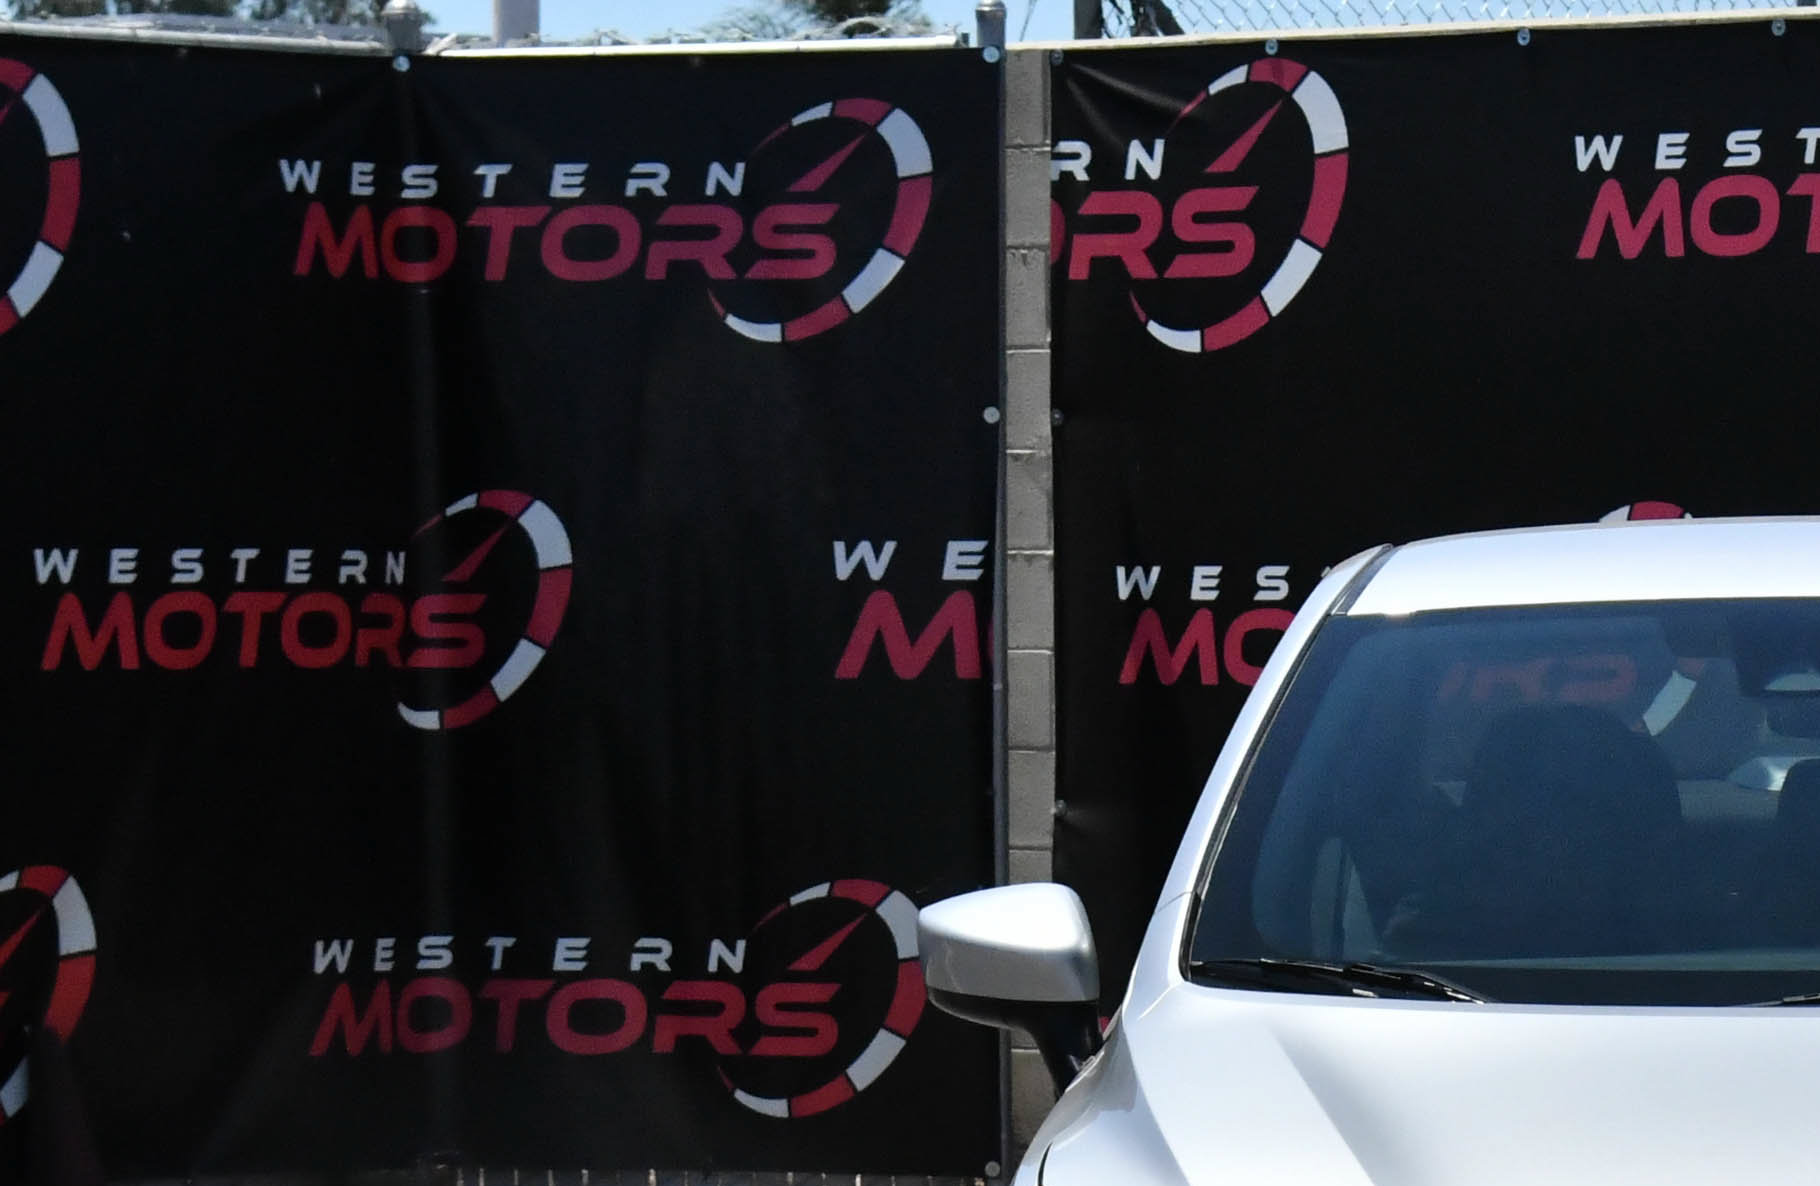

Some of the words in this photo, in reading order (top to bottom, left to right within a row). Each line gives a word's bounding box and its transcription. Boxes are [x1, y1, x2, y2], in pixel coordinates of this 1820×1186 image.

[280, 159, 746, 199] WESTERN
[294, 202, 840, 283] MOTORS
[34, 548, 406, 584] WESTERN
[42, 591, 487, 671] MOTORS
[314, 936, 746, 974] WESTERN
[309, 977, 841, 1057] MOTORS
